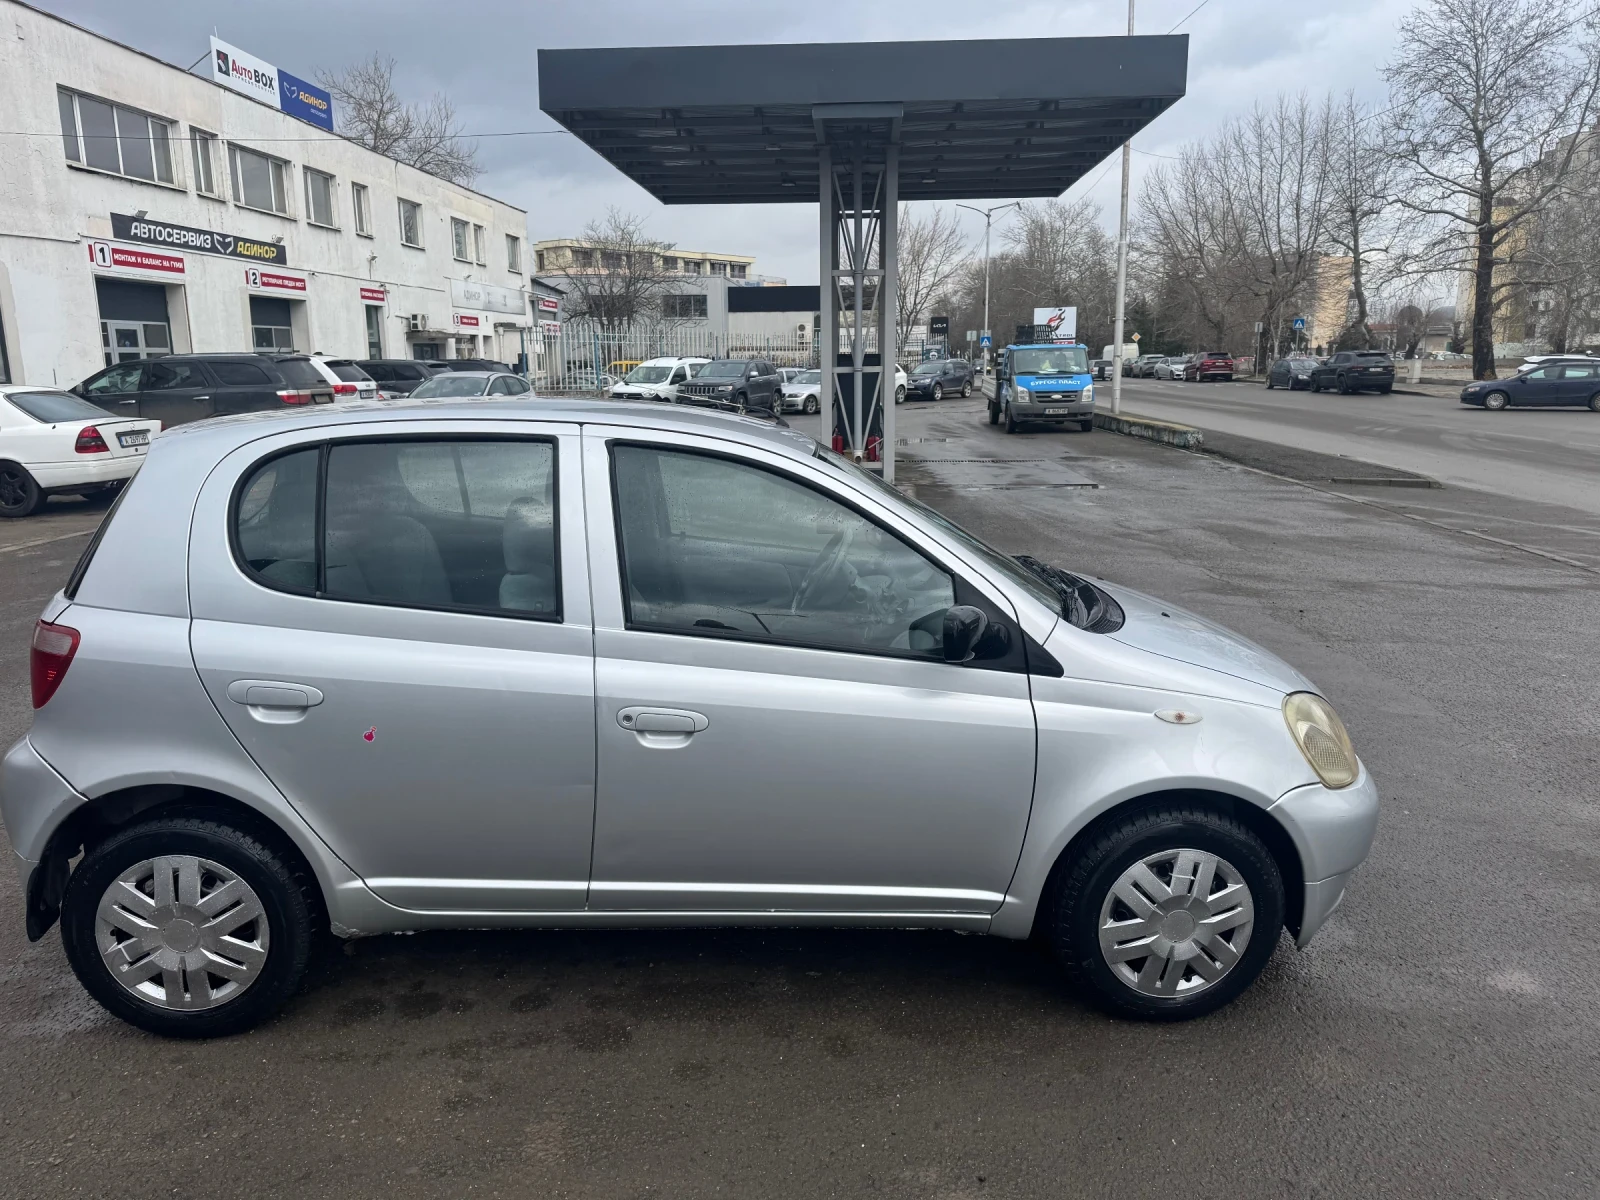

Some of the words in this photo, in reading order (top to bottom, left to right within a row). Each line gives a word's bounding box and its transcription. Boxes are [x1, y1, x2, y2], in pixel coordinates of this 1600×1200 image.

[253, 68, 275, 91] BOX
[299, 91, 328, 110] АДИНОР
[130, 222, 212, 249] АВТОСЕРВИЗ
[236, 241, 277, 260] АДИНОР
[98, 246, 106, 264] 1
[113, 253, 137, 263] МОНТАЖ
[137, 256, 142, 264] И
[142, 257, 162, 266] БАЛАНС
[163, 259, 170, 267] НА
[170, 260, 184, 269] ГУМИ
[251, 271, 258, 285] 2
